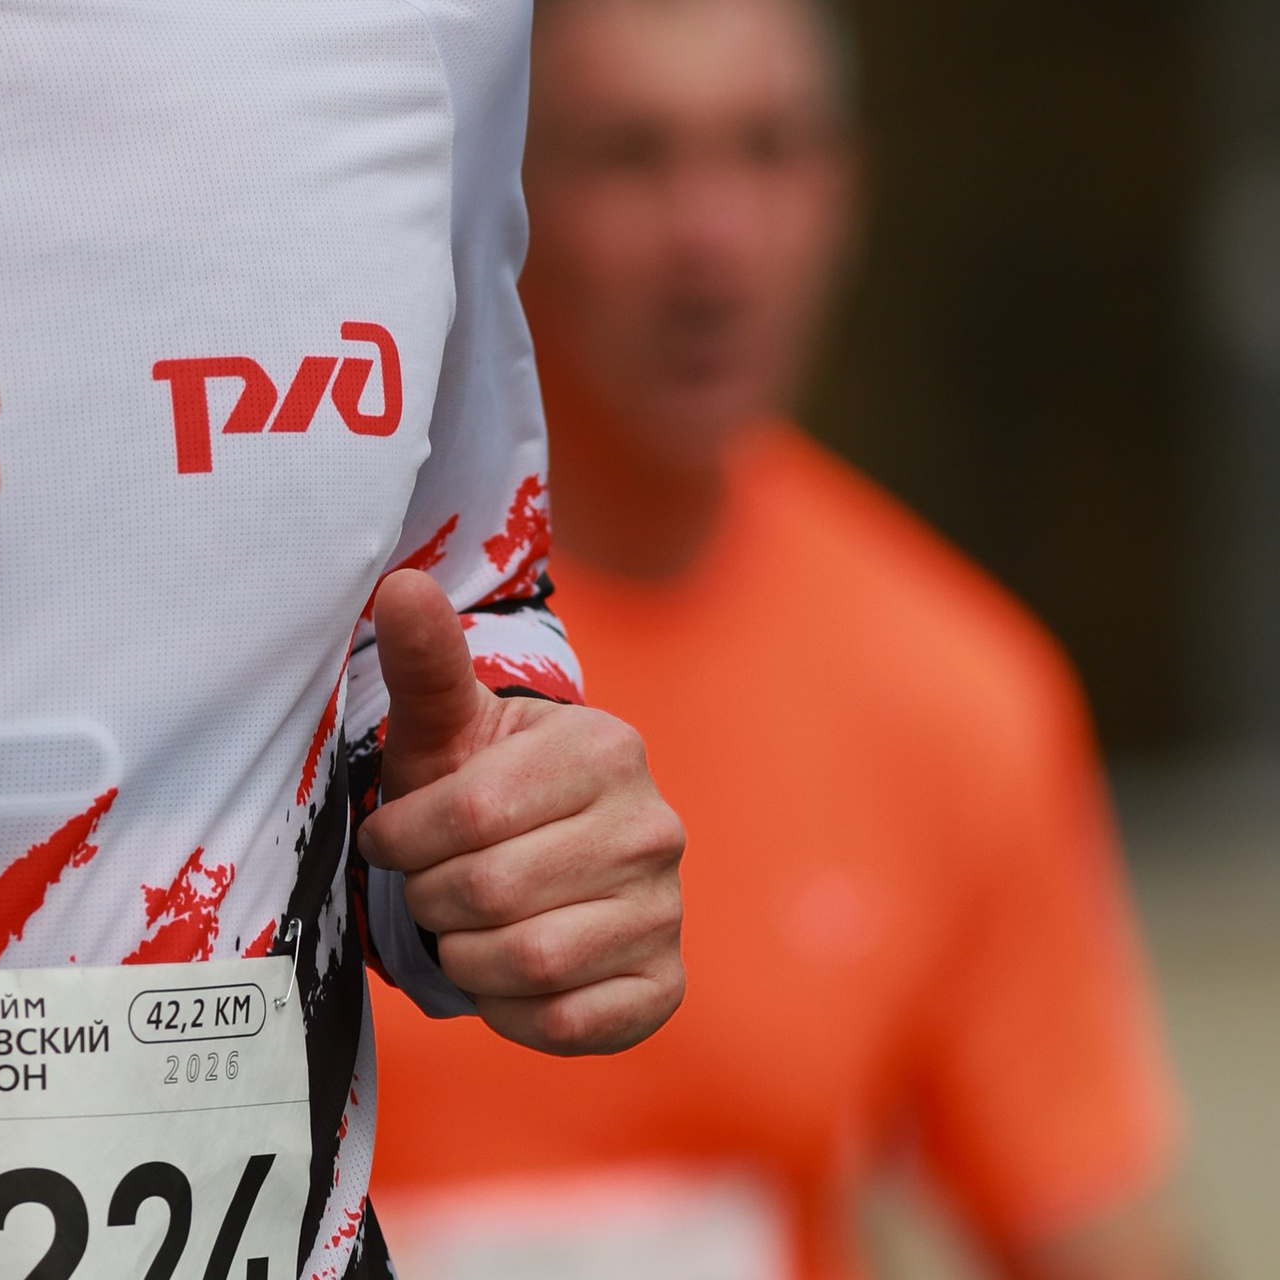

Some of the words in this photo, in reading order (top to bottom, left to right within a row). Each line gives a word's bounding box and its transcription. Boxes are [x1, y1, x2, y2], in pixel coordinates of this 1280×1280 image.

[146, 998, 205, 1033] 42,2
[215, 995, 251, 1026] КМ
[164, 1050, 239, 1084] 2026
